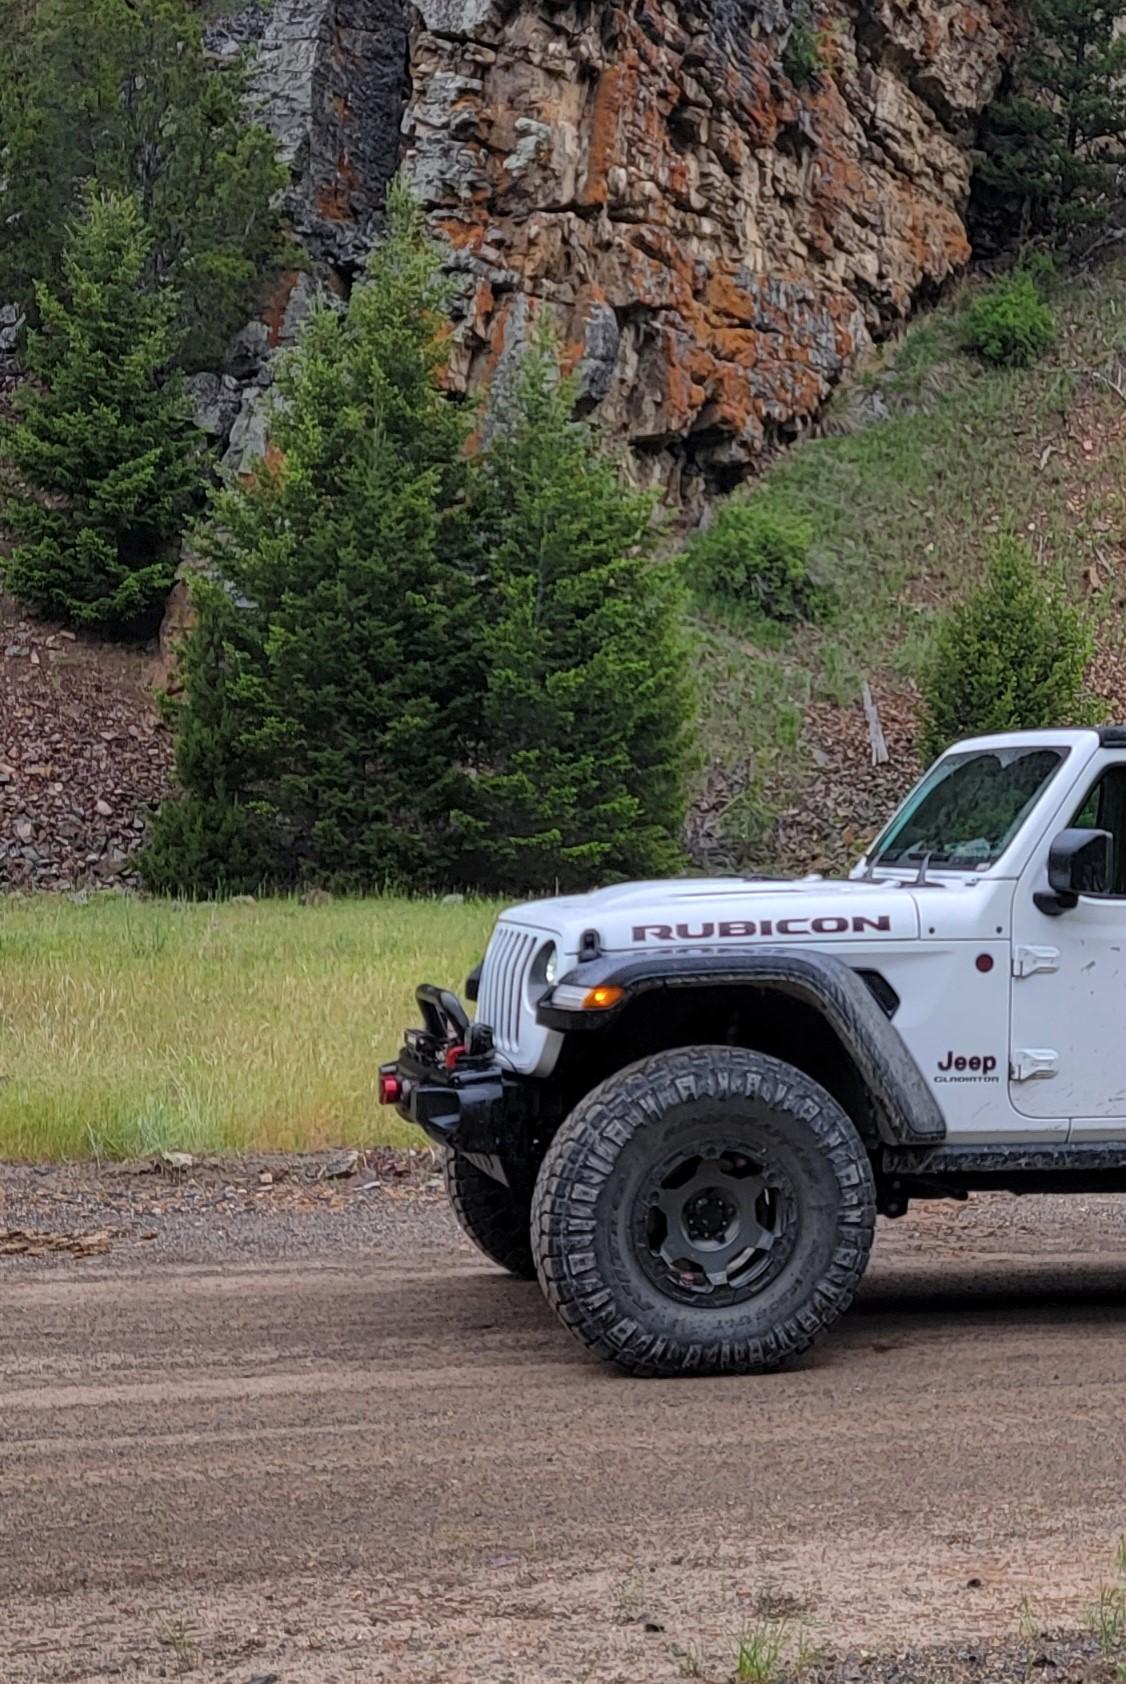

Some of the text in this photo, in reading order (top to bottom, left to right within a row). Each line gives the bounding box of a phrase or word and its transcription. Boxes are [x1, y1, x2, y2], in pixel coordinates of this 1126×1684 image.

[631, 915, 891, 942] RUBICON
[937, 1050, 997, 1075] Jeep
[933, 1075, 1000, 1083] GLADIATOR
